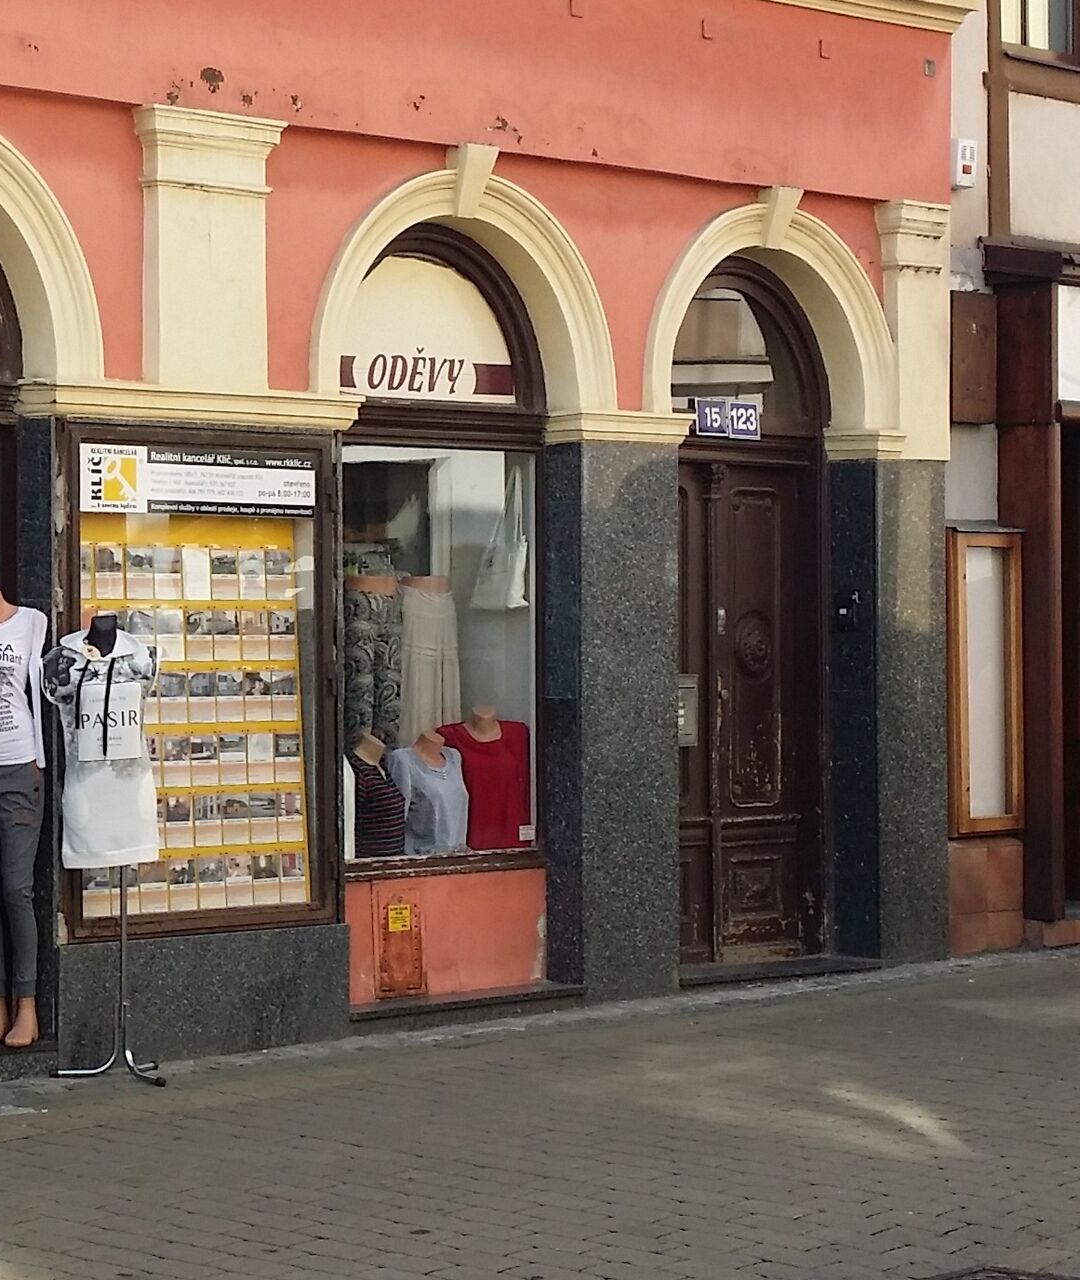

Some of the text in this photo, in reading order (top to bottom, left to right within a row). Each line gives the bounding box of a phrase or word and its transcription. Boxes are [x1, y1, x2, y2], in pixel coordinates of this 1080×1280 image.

[367, 347, 465, 395] ODĚVY
[704, 407, 721, 428] 15
[730, 407, 757, 431] 123
[87, 456, 102, 500] KLÍČ
[80, 709, 139, 730] PASIR
